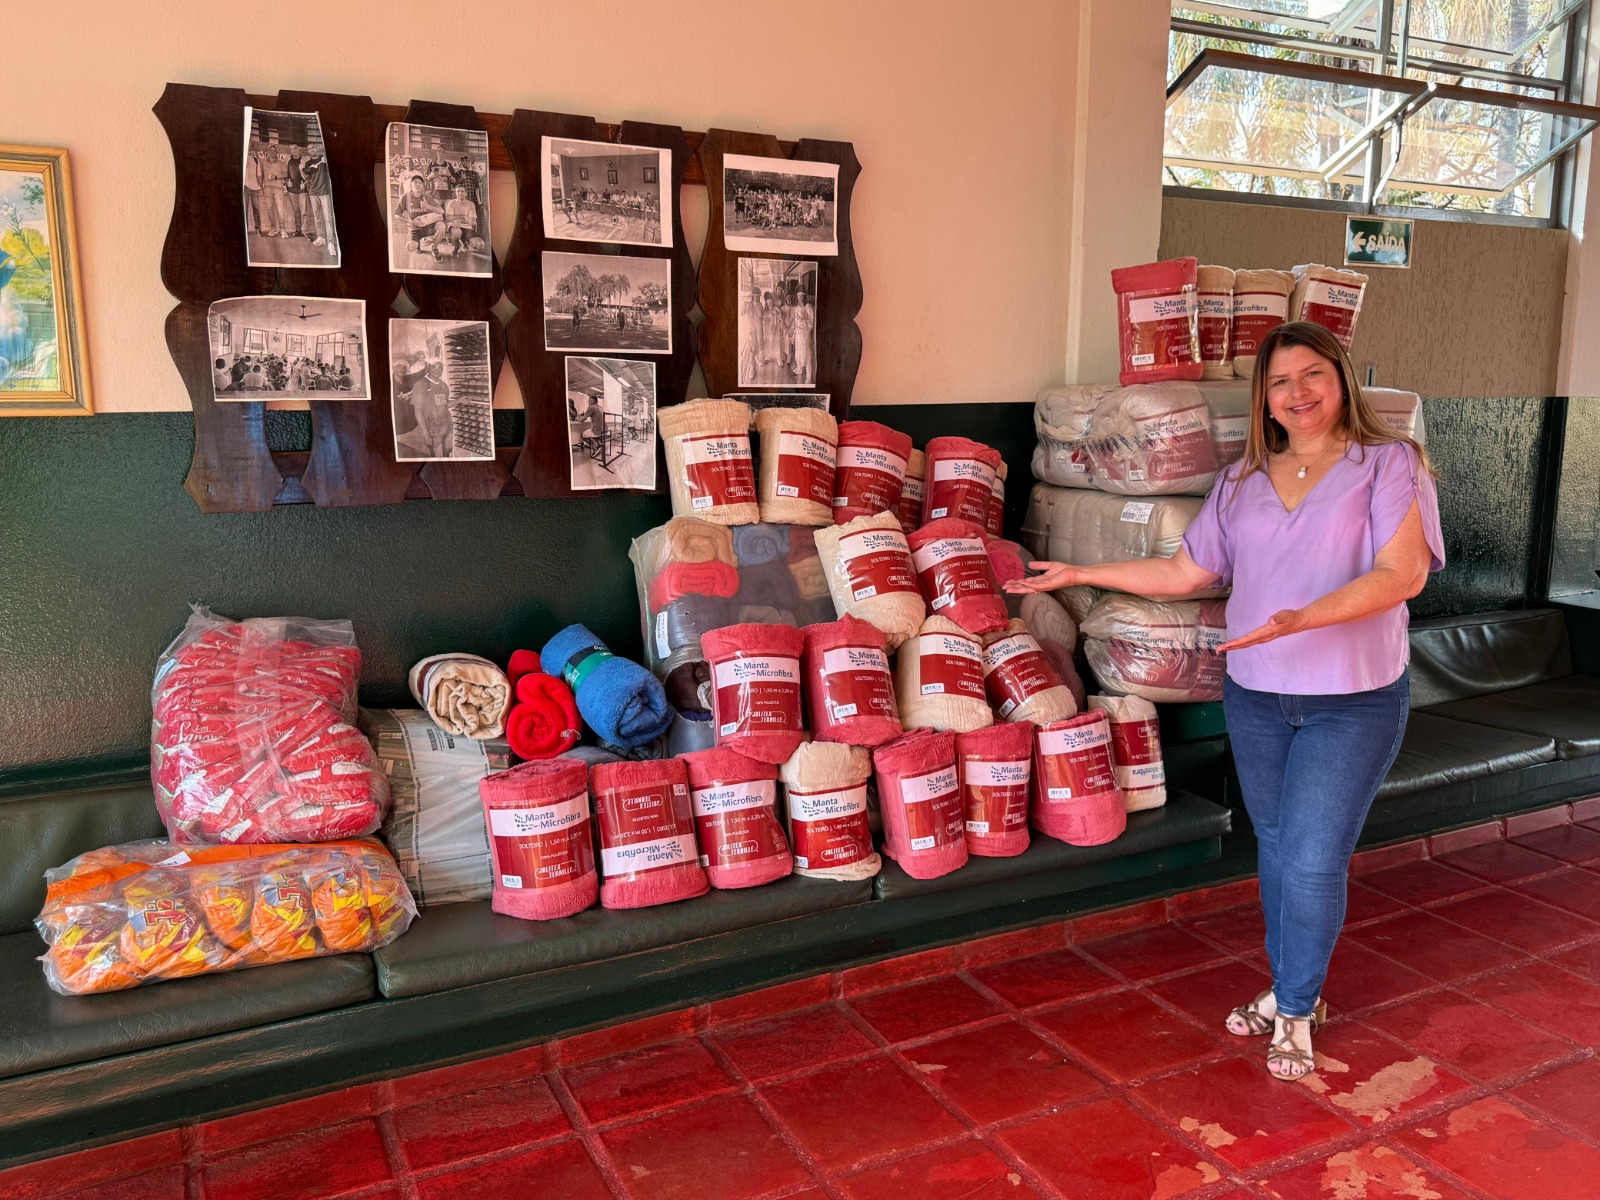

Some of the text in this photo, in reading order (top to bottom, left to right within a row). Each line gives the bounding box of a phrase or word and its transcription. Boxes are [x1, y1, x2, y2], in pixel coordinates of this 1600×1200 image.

[1368, 232, 1406, 252] SAÍDA
[1338, 290, 1358, 299] Manta
[811, 442, 828, 453] Manta
[865, 452, 887, 461] Manta
[963, 464, 982, 472] Manta
[954, 640, 974, 650] Manta
[990, 644, 1010, 655] Manta
[756, 669, 793, 678] Microfibra
[1074, 730, 1093, 739] Manta
[935, 773, 953, 783] Manta
[709, 791, 735, 800] Manta
[640, 801, 660, 809] JOLITEX
[722, 794, 762, 807] Microfibra
[813, 798, 837, 807] Manta
[826, 802, 860, 814] Microfibra
[525, 812, 554, 821] Manta
[540, 812, 580, 829] Microfibra
[617, 845, 660, 858] Microfibra
[648, 851, 673, 862] Manta
[539, 864, 560, 873] JOLITEX
